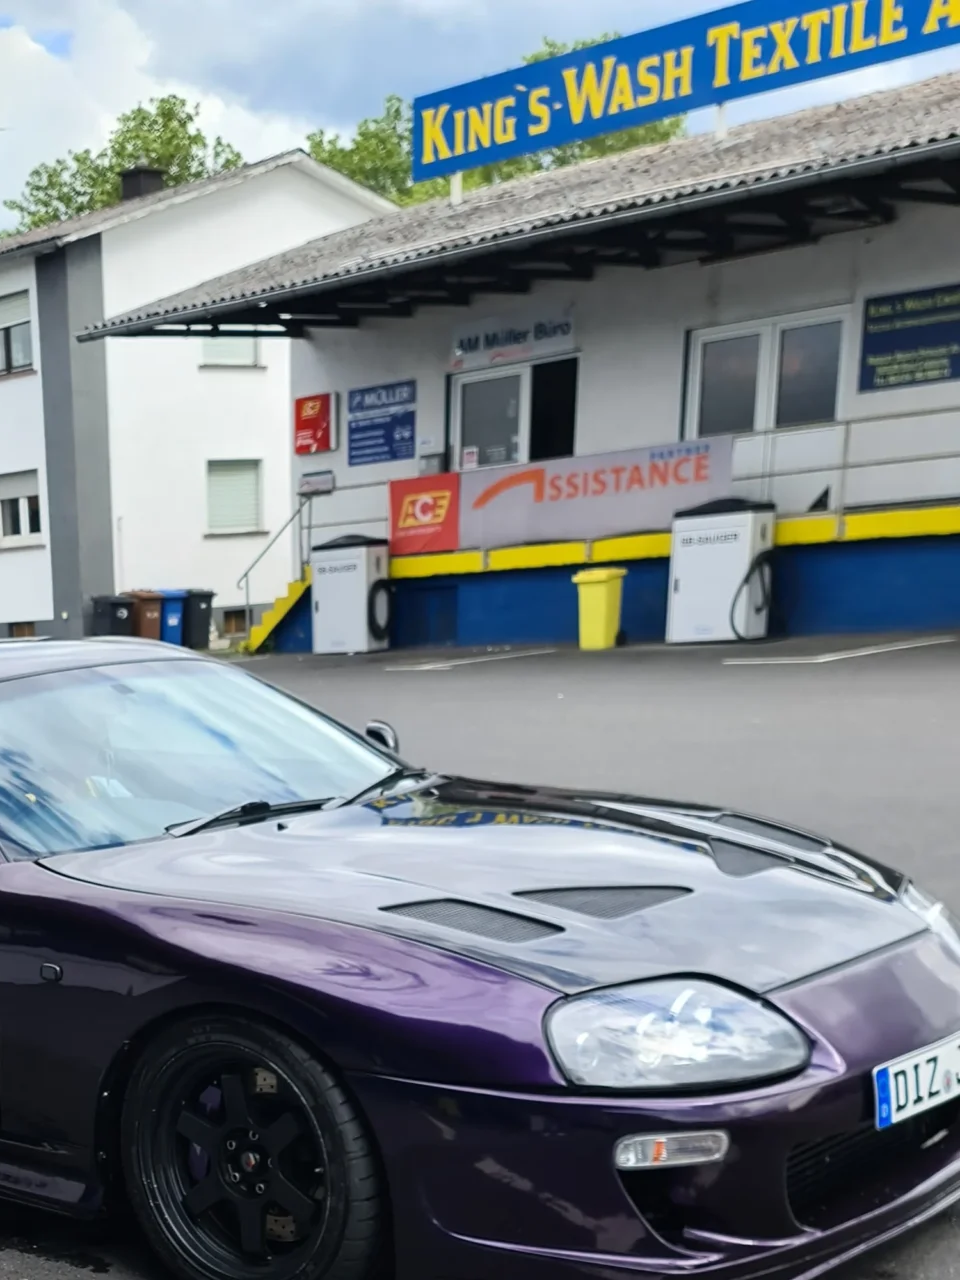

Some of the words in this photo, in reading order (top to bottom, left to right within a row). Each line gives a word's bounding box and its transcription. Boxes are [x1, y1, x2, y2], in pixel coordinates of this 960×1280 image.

[707, 0, 908, 88] TEXTILE
[398, 489, 452, 529] ACE
[893, 1055, 941, 1113] DIZ
